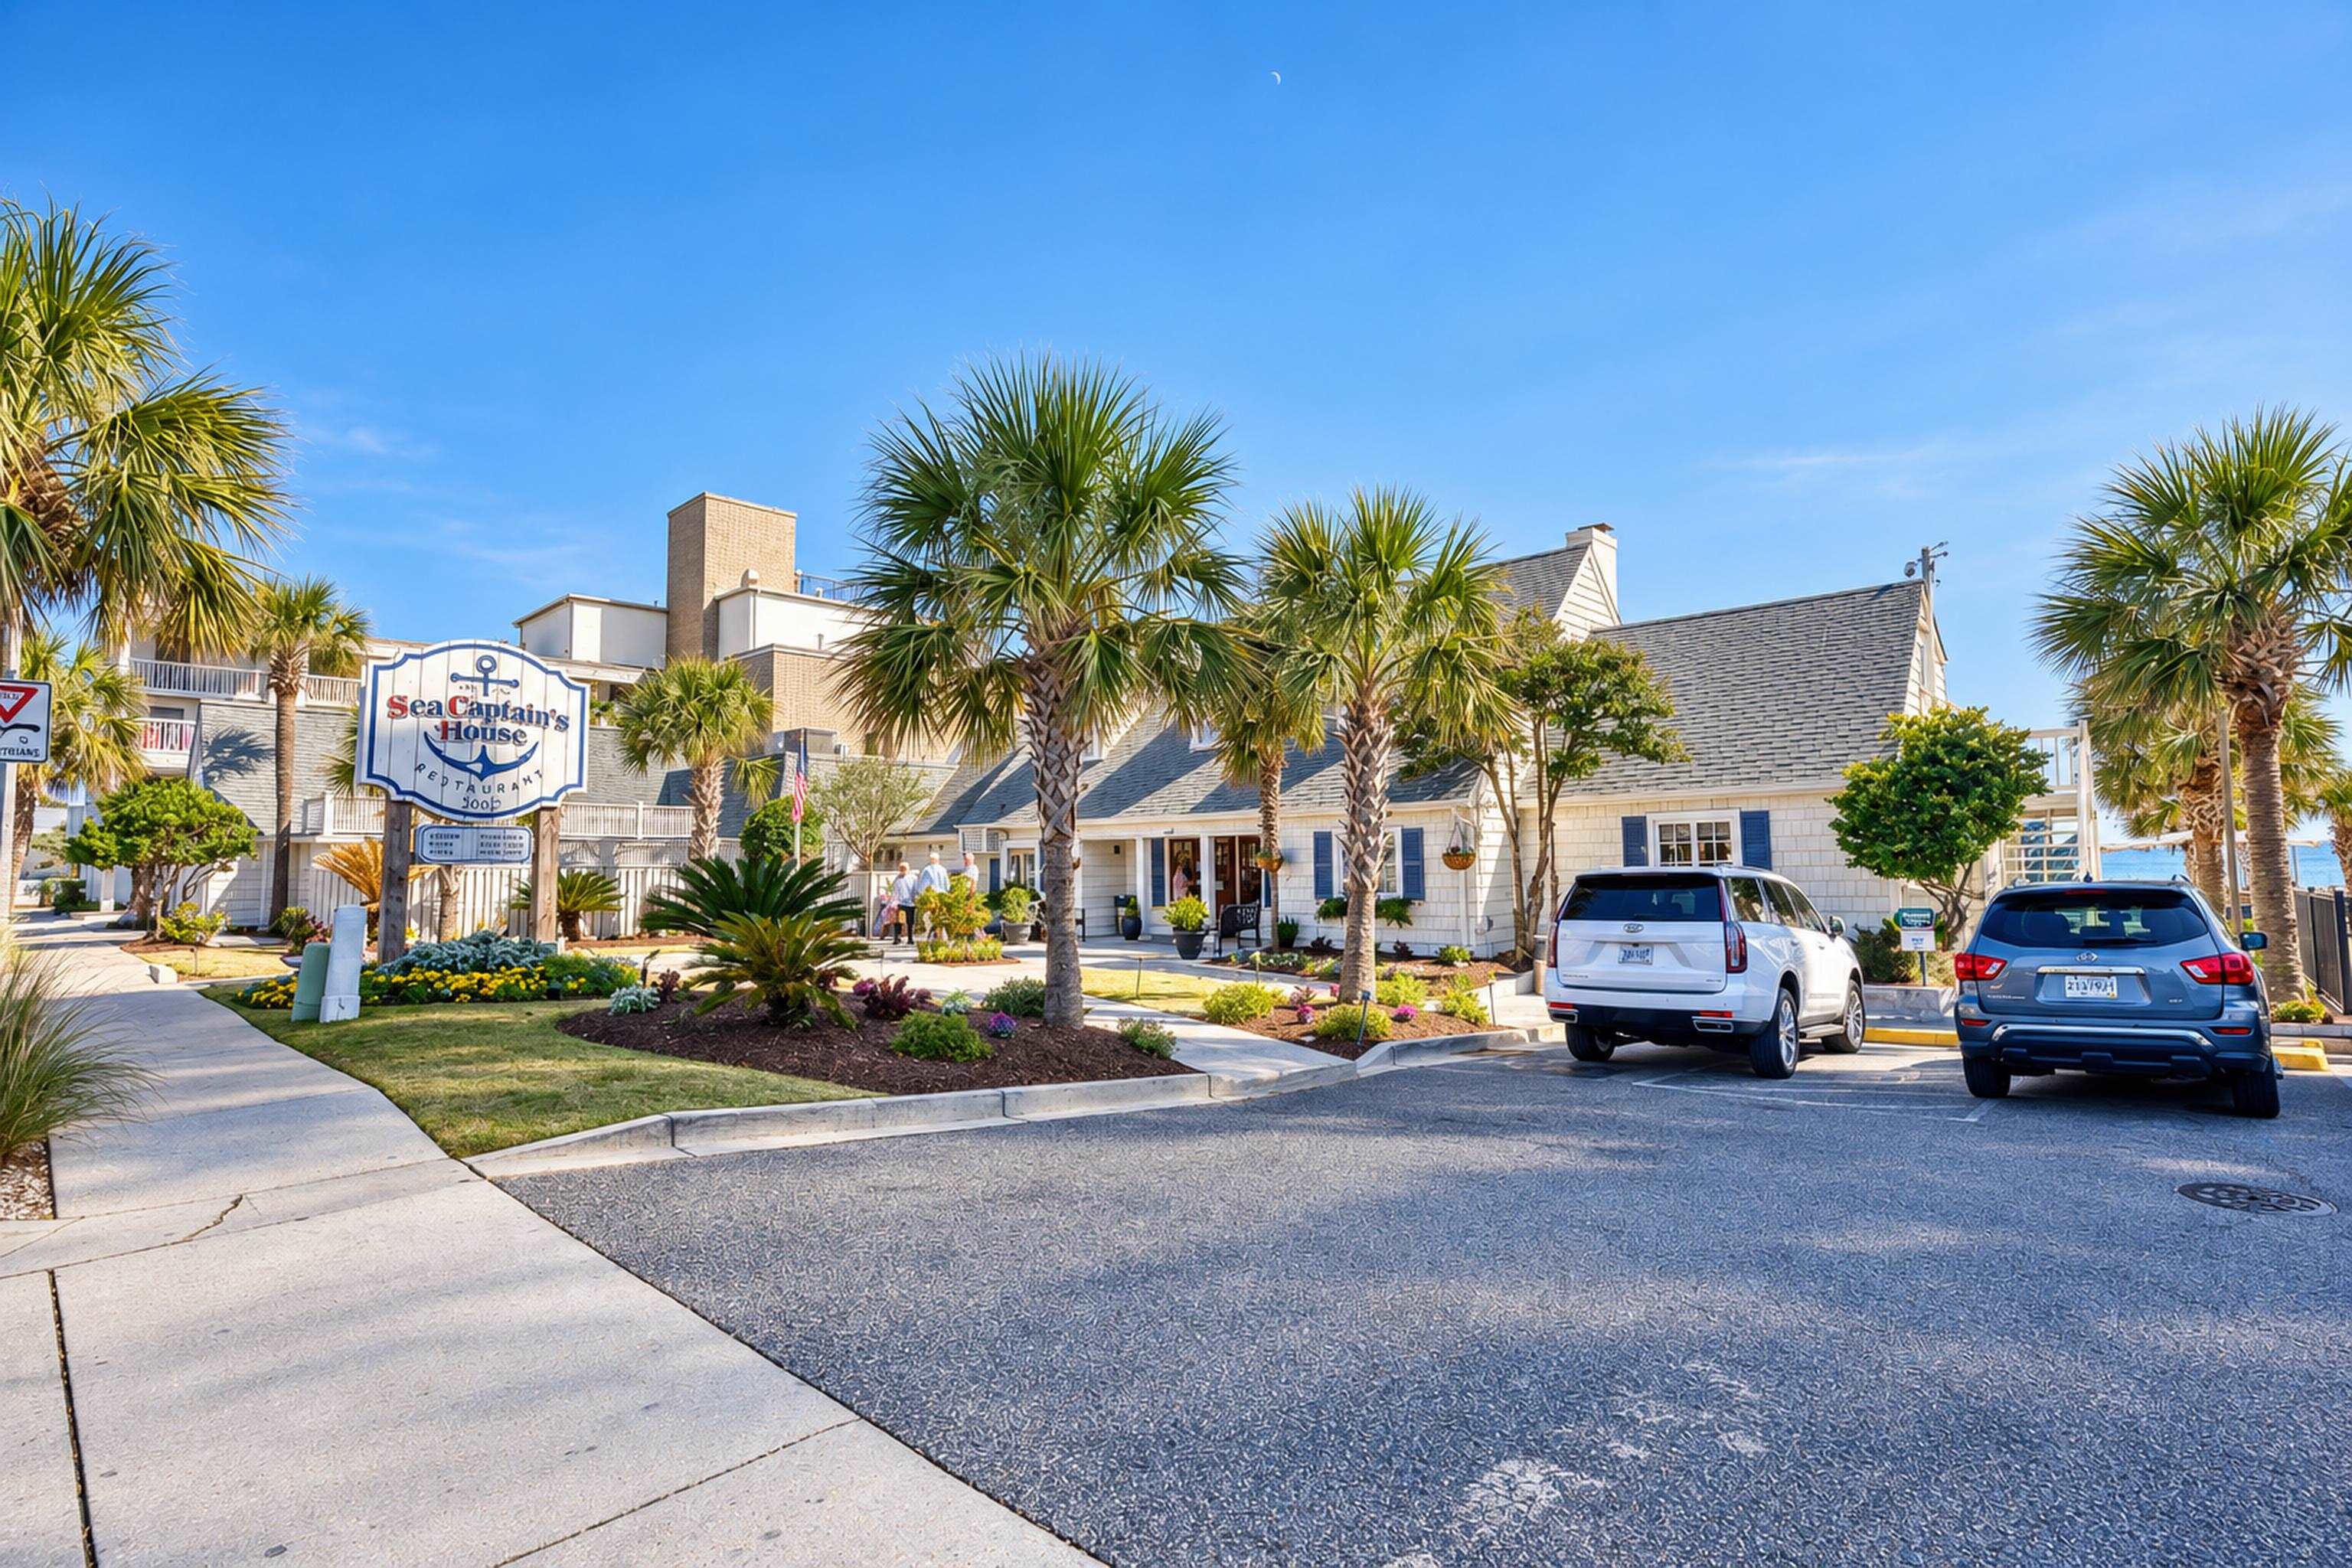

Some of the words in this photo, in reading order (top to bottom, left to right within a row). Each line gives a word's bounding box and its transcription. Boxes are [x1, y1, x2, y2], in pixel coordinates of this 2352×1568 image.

[387, 695, 443, 718] Sea
[448, 695, 570, 732] Captain's
[435, 720, 528, 746] House
